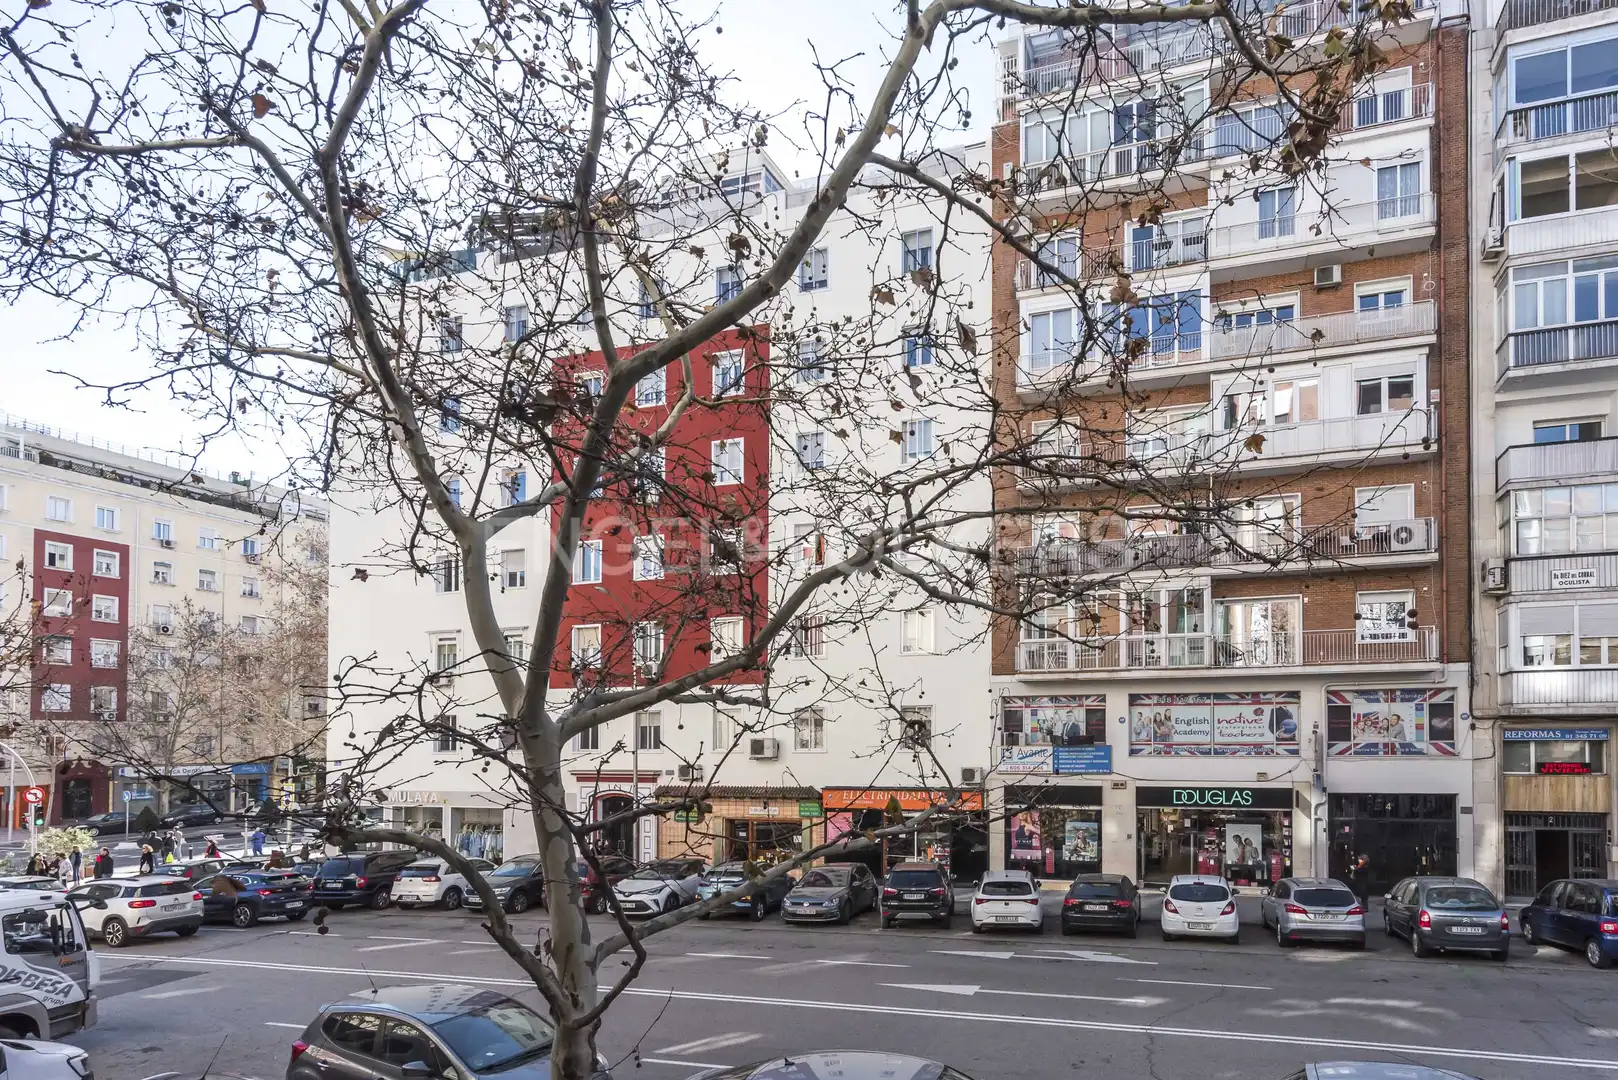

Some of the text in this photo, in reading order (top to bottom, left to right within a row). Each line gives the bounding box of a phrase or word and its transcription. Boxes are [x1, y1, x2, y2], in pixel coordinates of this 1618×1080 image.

[1175, 717, 1210, 728] English
[1217, 713, 1265, 724] native
[1173, 729, 1210, 738] Academy
[1217, 729, 1265, 738] teachers
[1505, 730, 1562, 739] REFORMAS
[182, 767, 204, 775] Dental
[388, 791, 438, 803] MULAYA
[843, 790, 927, 801] ELECTRICIDAD
[1173, 789, 1252, 806] DOUGLAS
[1385, 802, 1391, 811] 4
[0, 965, 74, 998] DISBESA
[43, 995, 65, 1006] grupo
